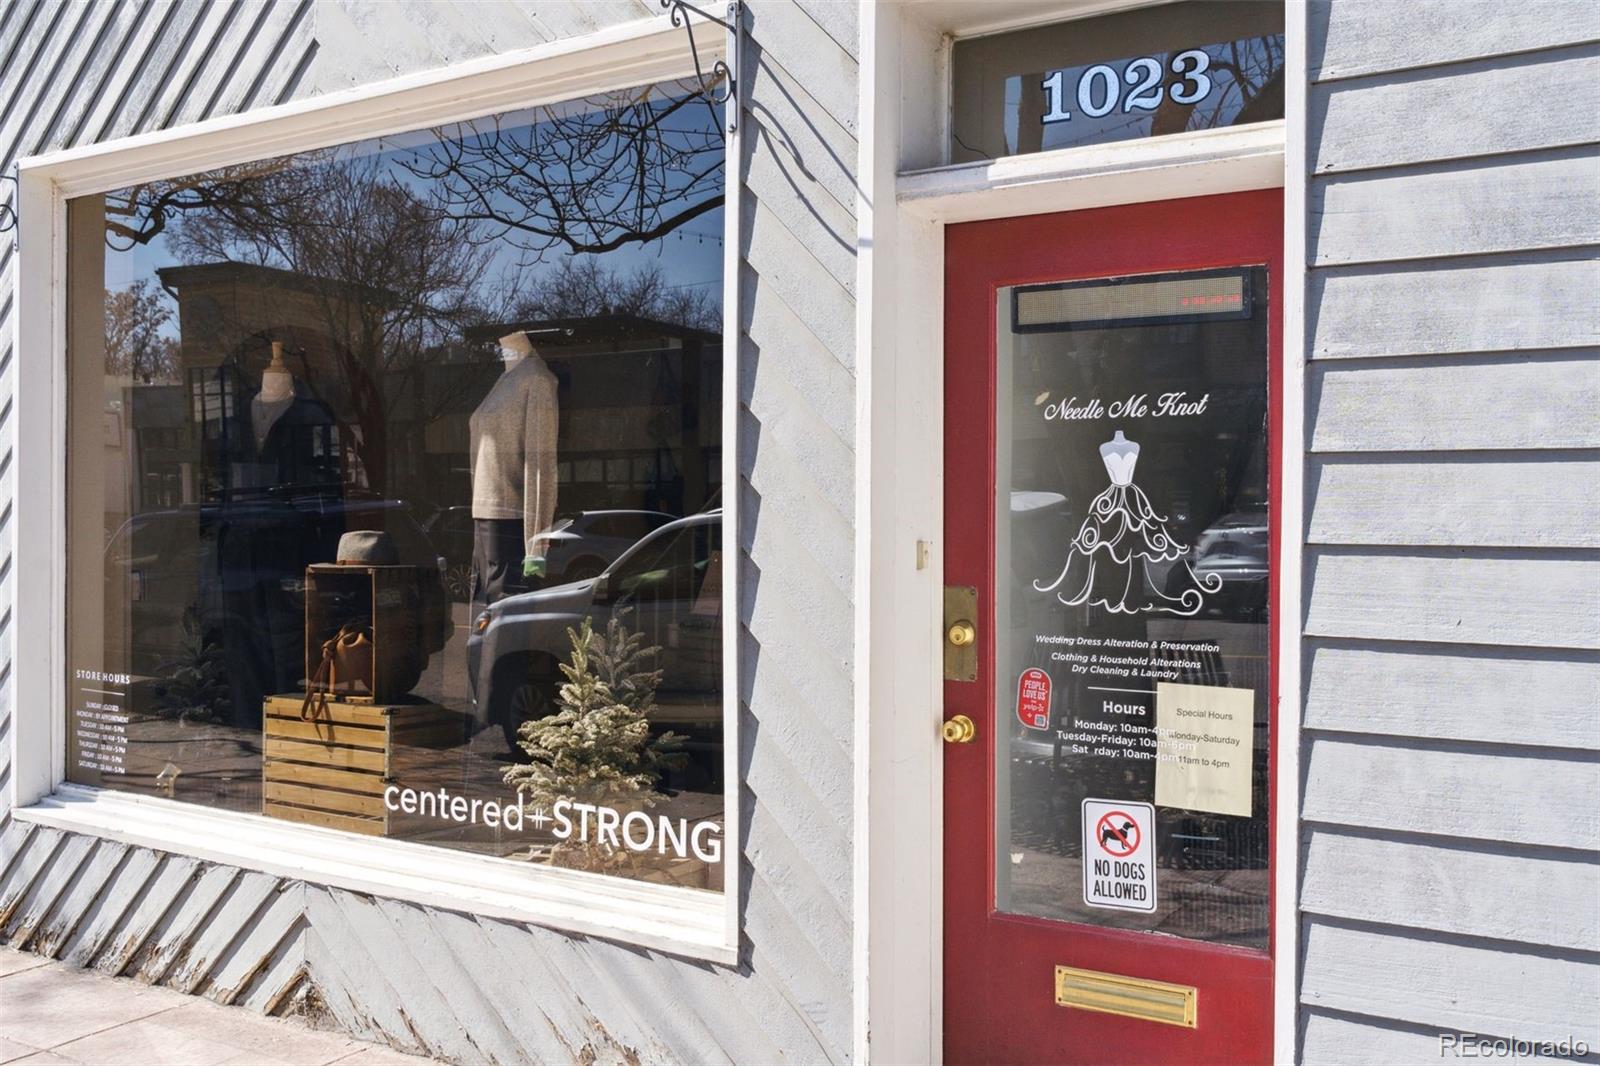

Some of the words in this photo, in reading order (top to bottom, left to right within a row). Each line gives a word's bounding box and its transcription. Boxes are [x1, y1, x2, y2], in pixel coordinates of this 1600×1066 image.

[1041, 48, 1213, 125] 1023
[1044, 397, 1104, 420] Needle
[1108, 394, 1148, 418] Me
[1152, 392, 1209, 416] Knot
[1036, 635, 1074, 646] Wedding
[1077, 637, 1101, 646] Dress
[1103, 639, 1149, 648] Alteration
[1160, 642, 1220, 652] Preservation
[1051, 652, 1088, 663] Clothing
[1100, 657, 1148, 666] Household
[1150, 659, 1201, 669] Alterations
[76, 669, 101, 681] STORE
[102, 673, 131, 685] HOURS
[1072, 665, 1088, 674] Dry
[1090, 667, 1129, 677] Cleaning
[1140, 670, 1179, 680] Laundry
[1103, 701, 1146, 716] Hours
[1176, 708, 1206, 718] Special
[1208, 711, 1233, 720] Hours
[1075, 719, 1117, 733] Monday:
[1056, 731, 1137, 746] Tuesday-Friday:
[1201, 757, 1210, 766] to
[1211, 759, 1230, 769] 4pm
[1094, 859, 1110, 877] NO
[1114, 861, 1145, 880] DOGS
[1093, 880, 1147, 901] ALLOWED
